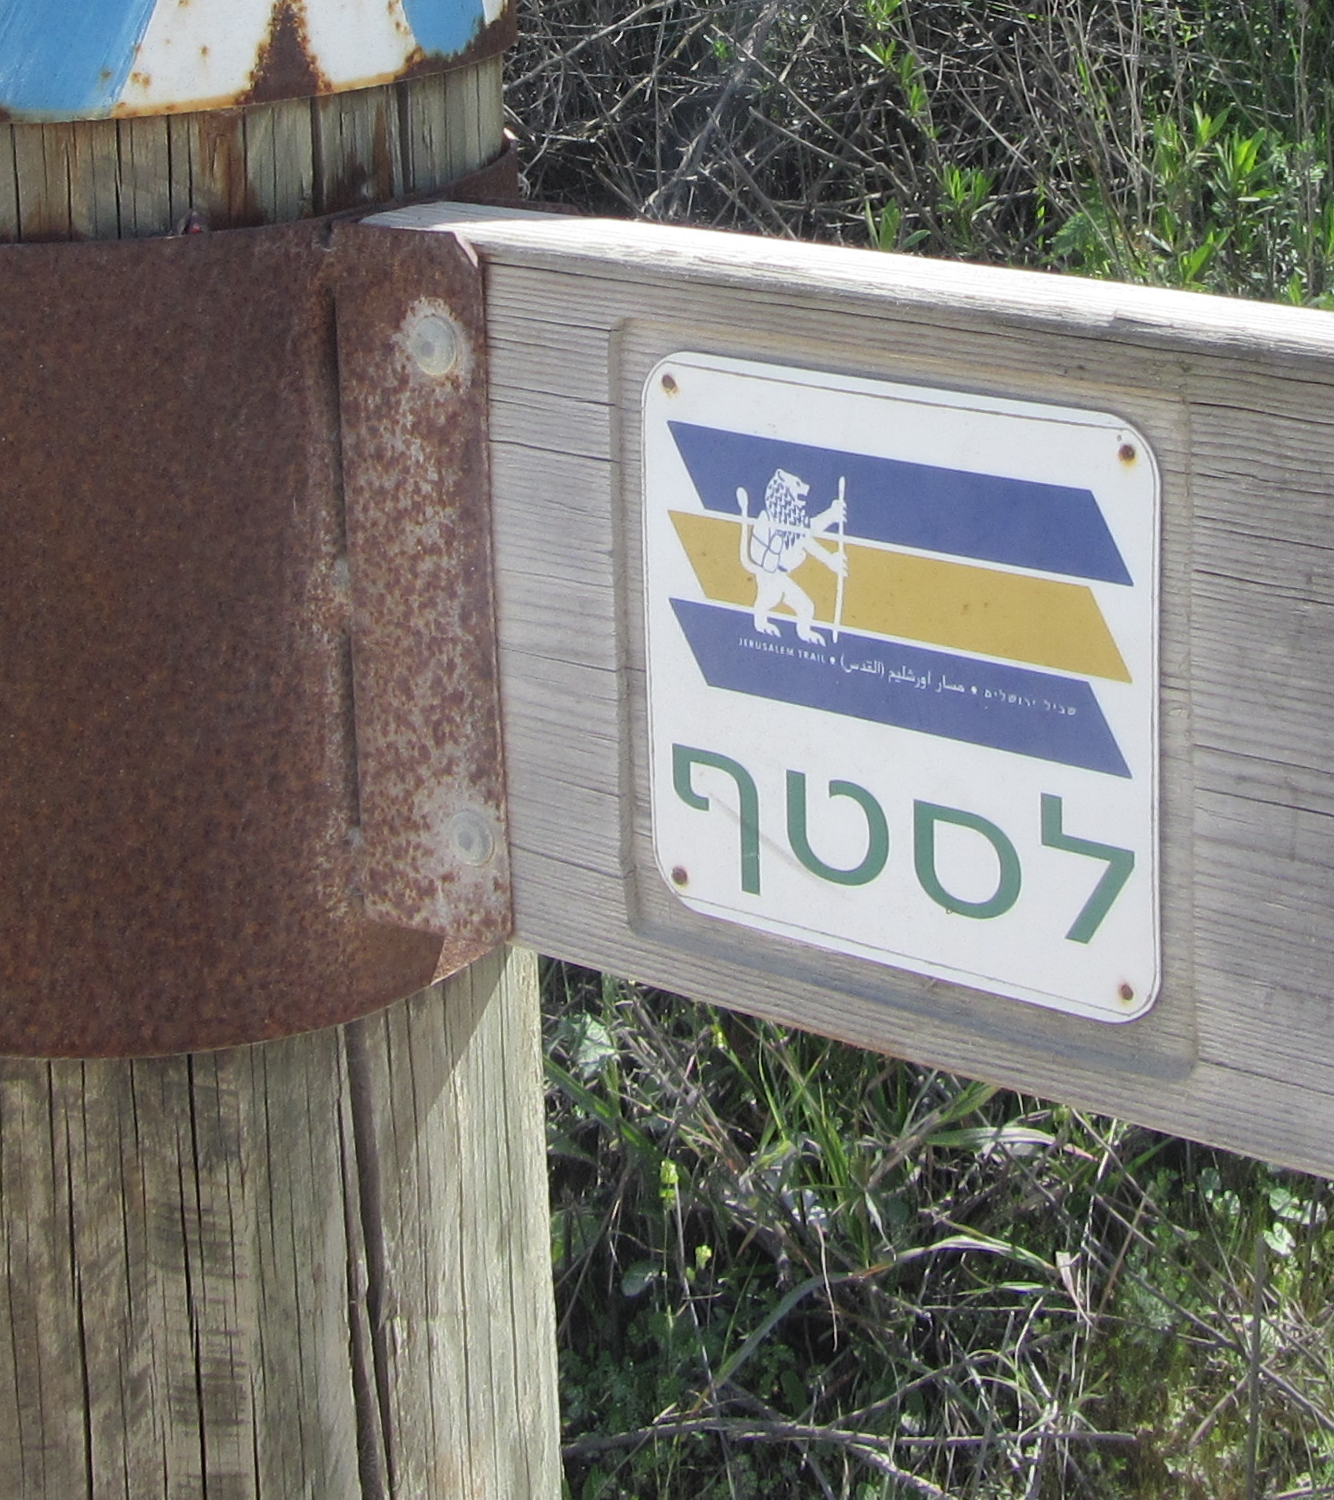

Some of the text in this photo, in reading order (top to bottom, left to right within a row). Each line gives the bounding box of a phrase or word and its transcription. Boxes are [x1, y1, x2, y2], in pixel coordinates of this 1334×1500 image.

[738, 638, 826, 664] JERUSALEM TRAIL
[672, 743, 1135, 944] לסטף
